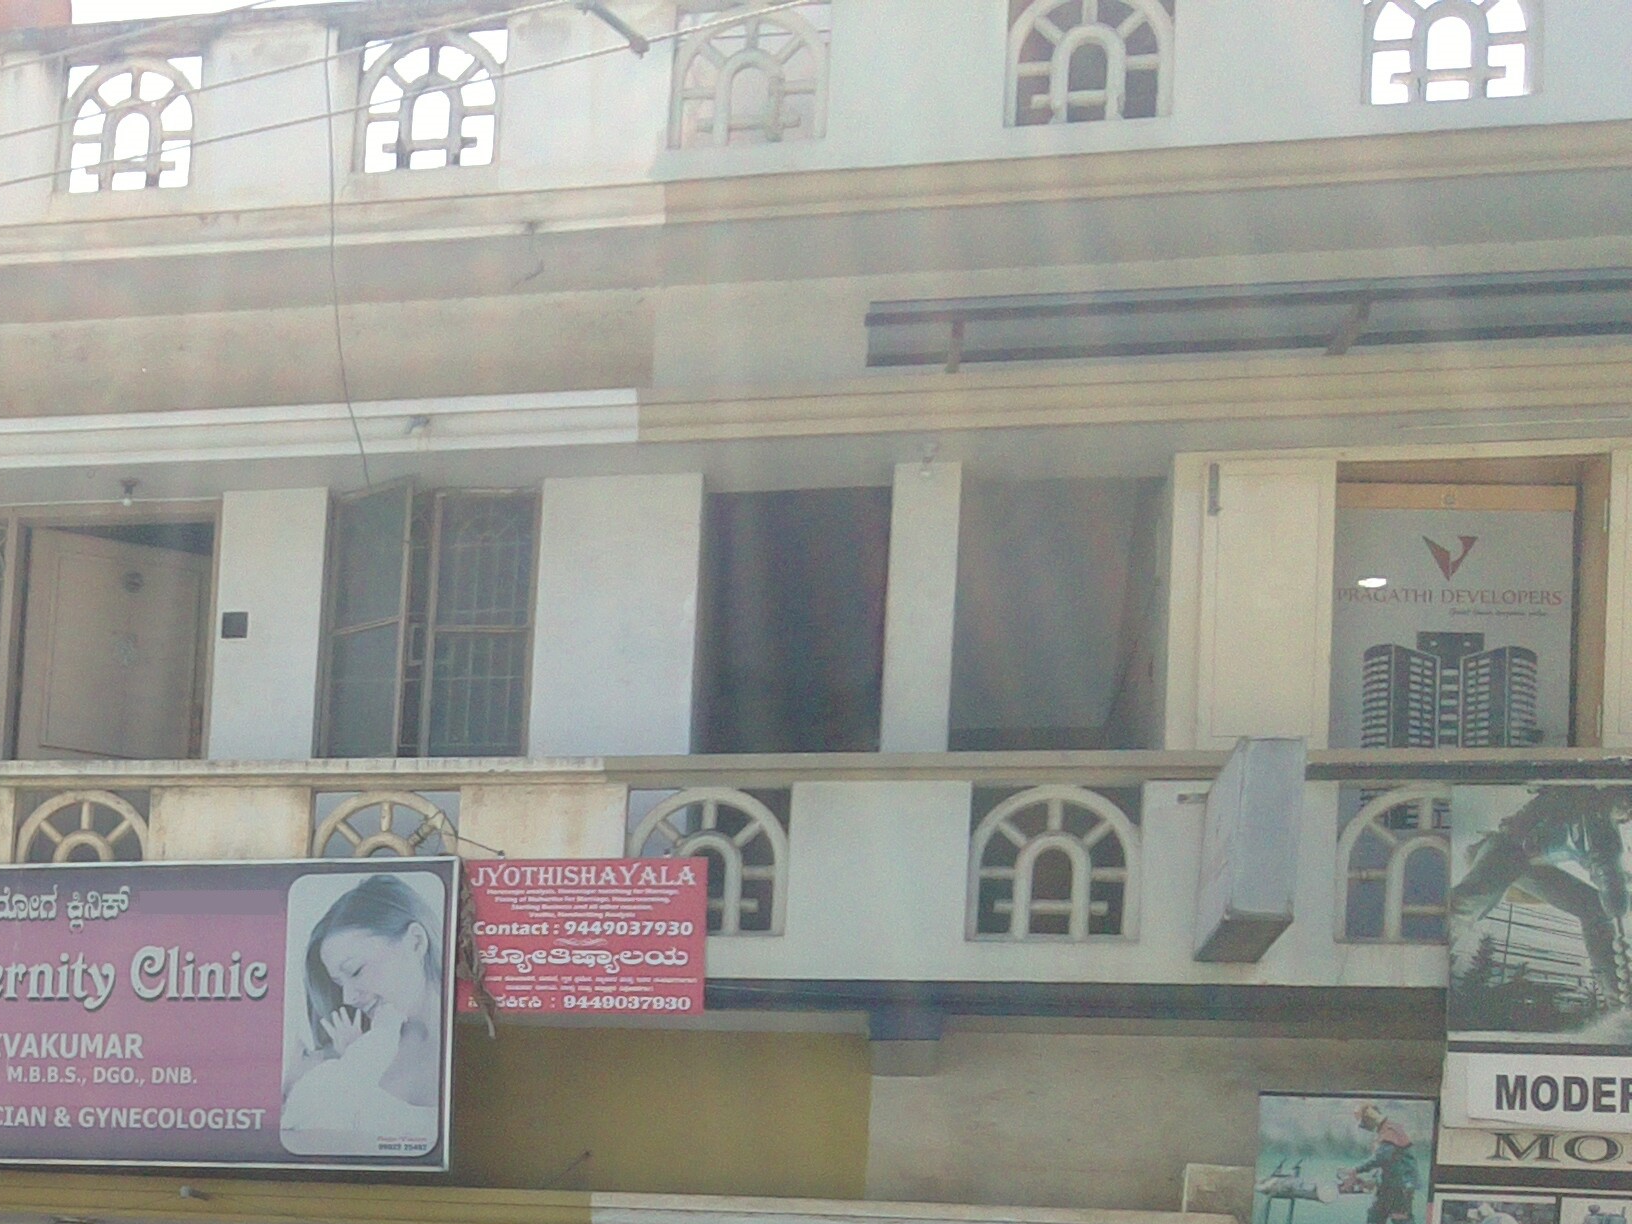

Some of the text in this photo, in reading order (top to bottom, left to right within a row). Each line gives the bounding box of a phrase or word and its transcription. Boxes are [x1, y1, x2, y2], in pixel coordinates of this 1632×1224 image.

[1441, 588, 1563, 606] DEVELOPERS
[470, 862, 697, 887] JYOTHISHAYALA
[66, 884, 130, 933] ಕ್ಲಿನಿಕ್
[473, 921, 550, 936] Contact
[563, 920, 694, 937] 9449037930
[129, 943, 269, 1001] Clinic
[562, 995, 692, 1011] 9449037930
[6, 1065, 197, 1088] M.B.B.S., DGO., DNB.
[54, 1106, 72, 1128] &
[78, 1106, 267, 1131] GYNECOLOGIST
